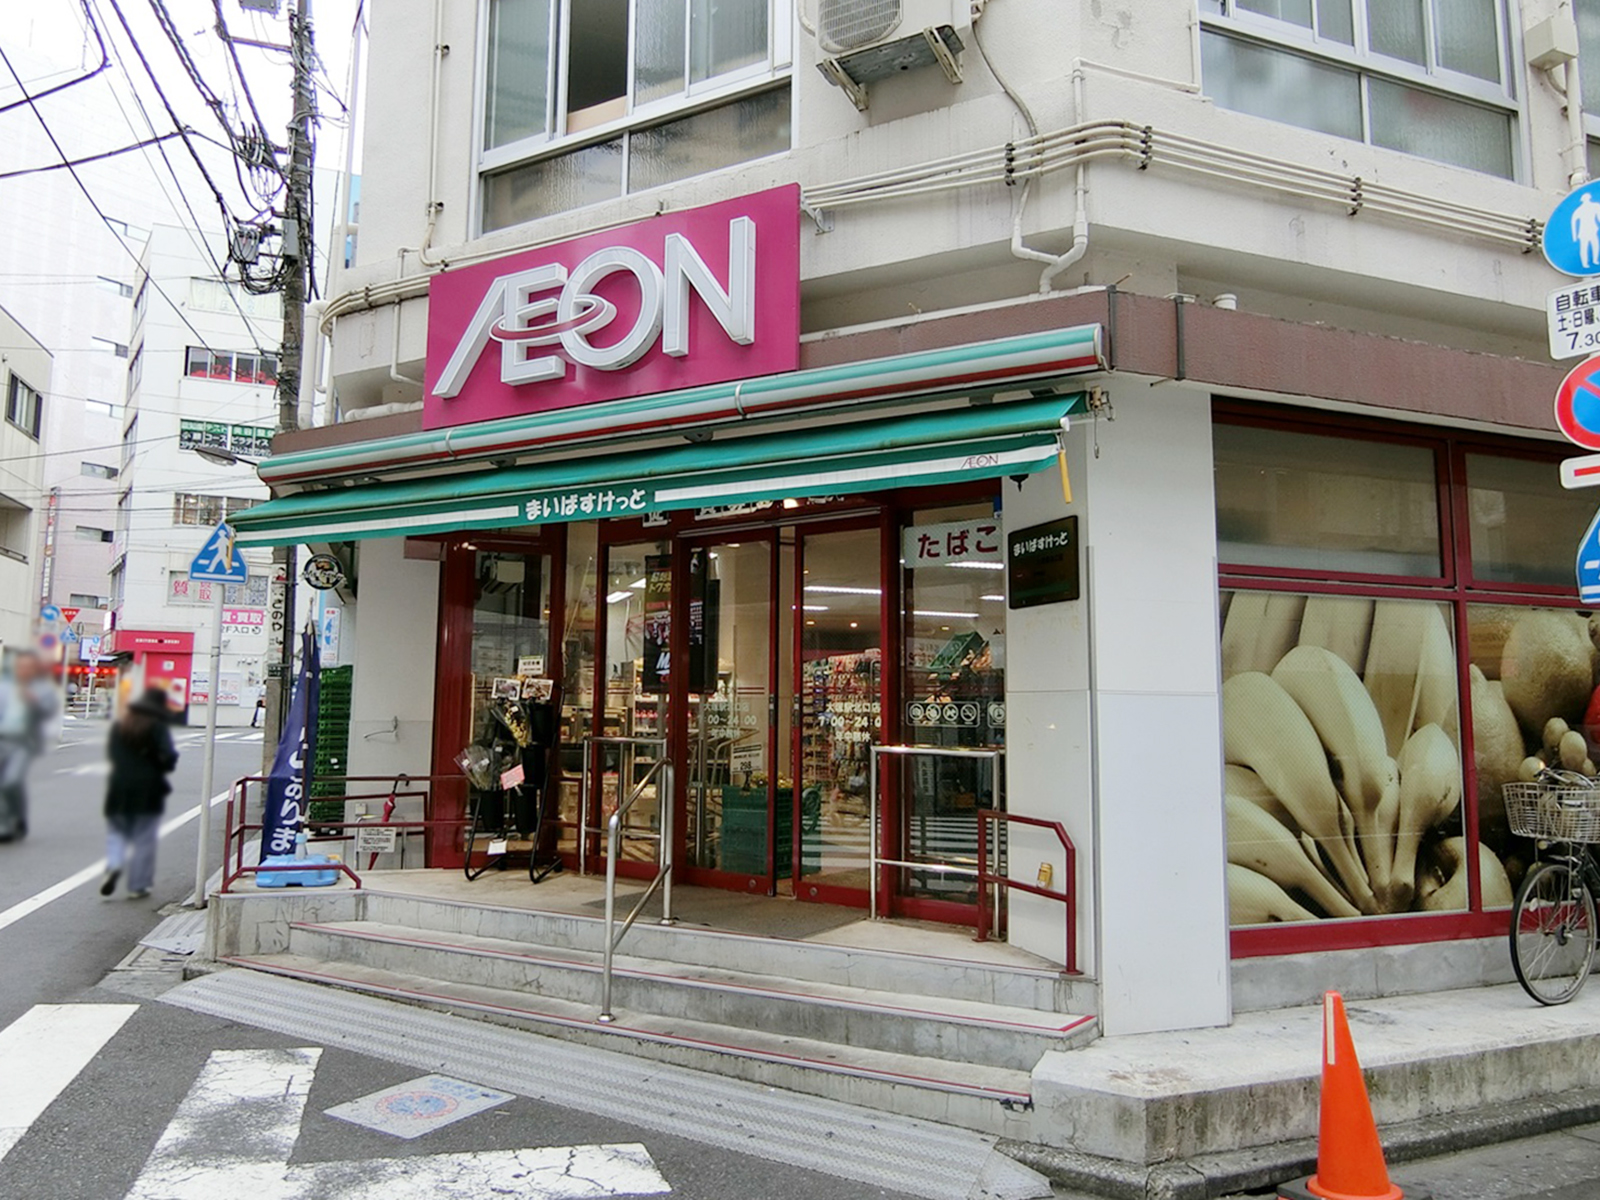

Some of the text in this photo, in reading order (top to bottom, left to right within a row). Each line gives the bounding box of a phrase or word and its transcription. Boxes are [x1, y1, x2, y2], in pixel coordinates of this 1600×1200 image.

[525, 487, 647, 520] まいばすけっと
[918, 526, 998, 559] たばこ
[1013, 531, 1068, 557] まいばすけっと
